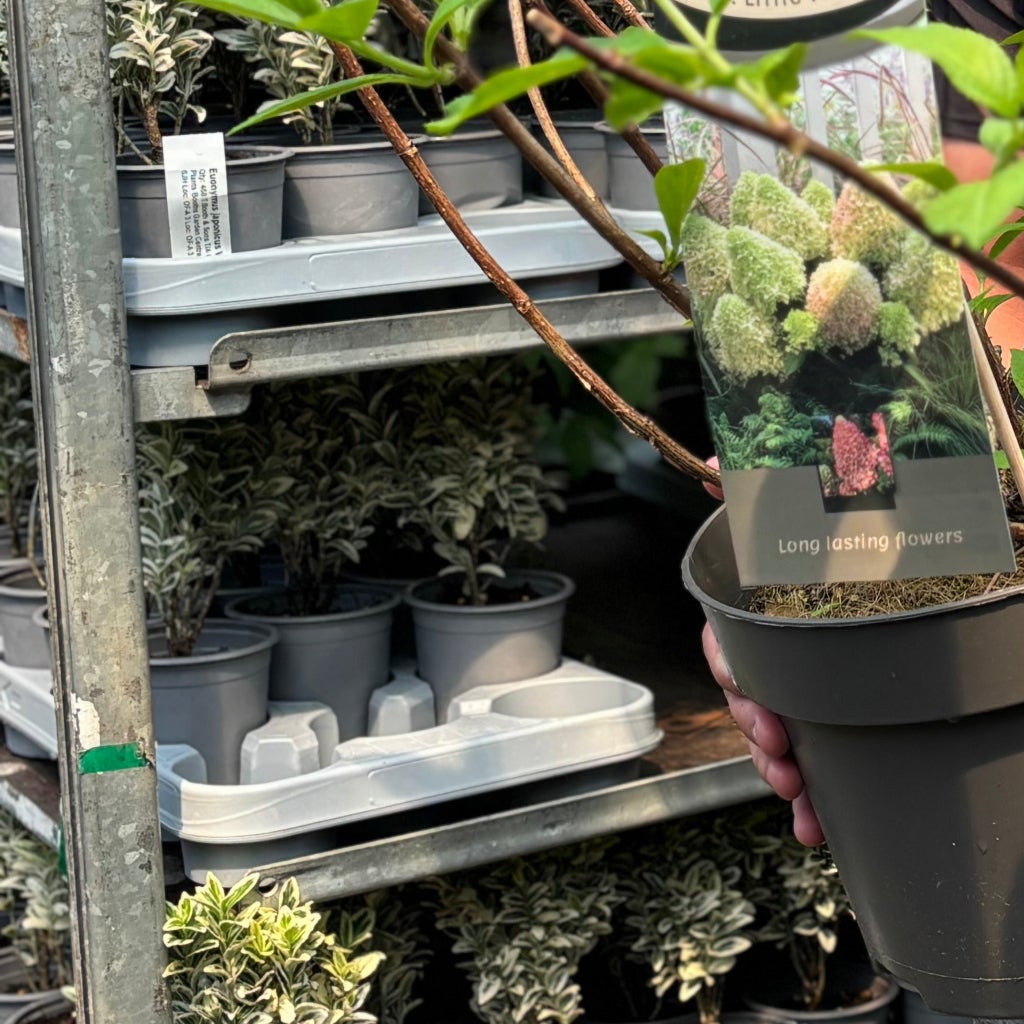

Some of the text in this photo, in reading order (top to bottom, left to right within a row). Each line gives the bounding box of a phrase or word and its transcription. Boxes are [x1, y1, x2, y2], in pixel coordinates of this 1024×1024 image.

[208, 168, 219, 212] Euonymus
[210, 213, 222, 250] japonicus
[778, 529, 964, 556] Long lasting flowers
